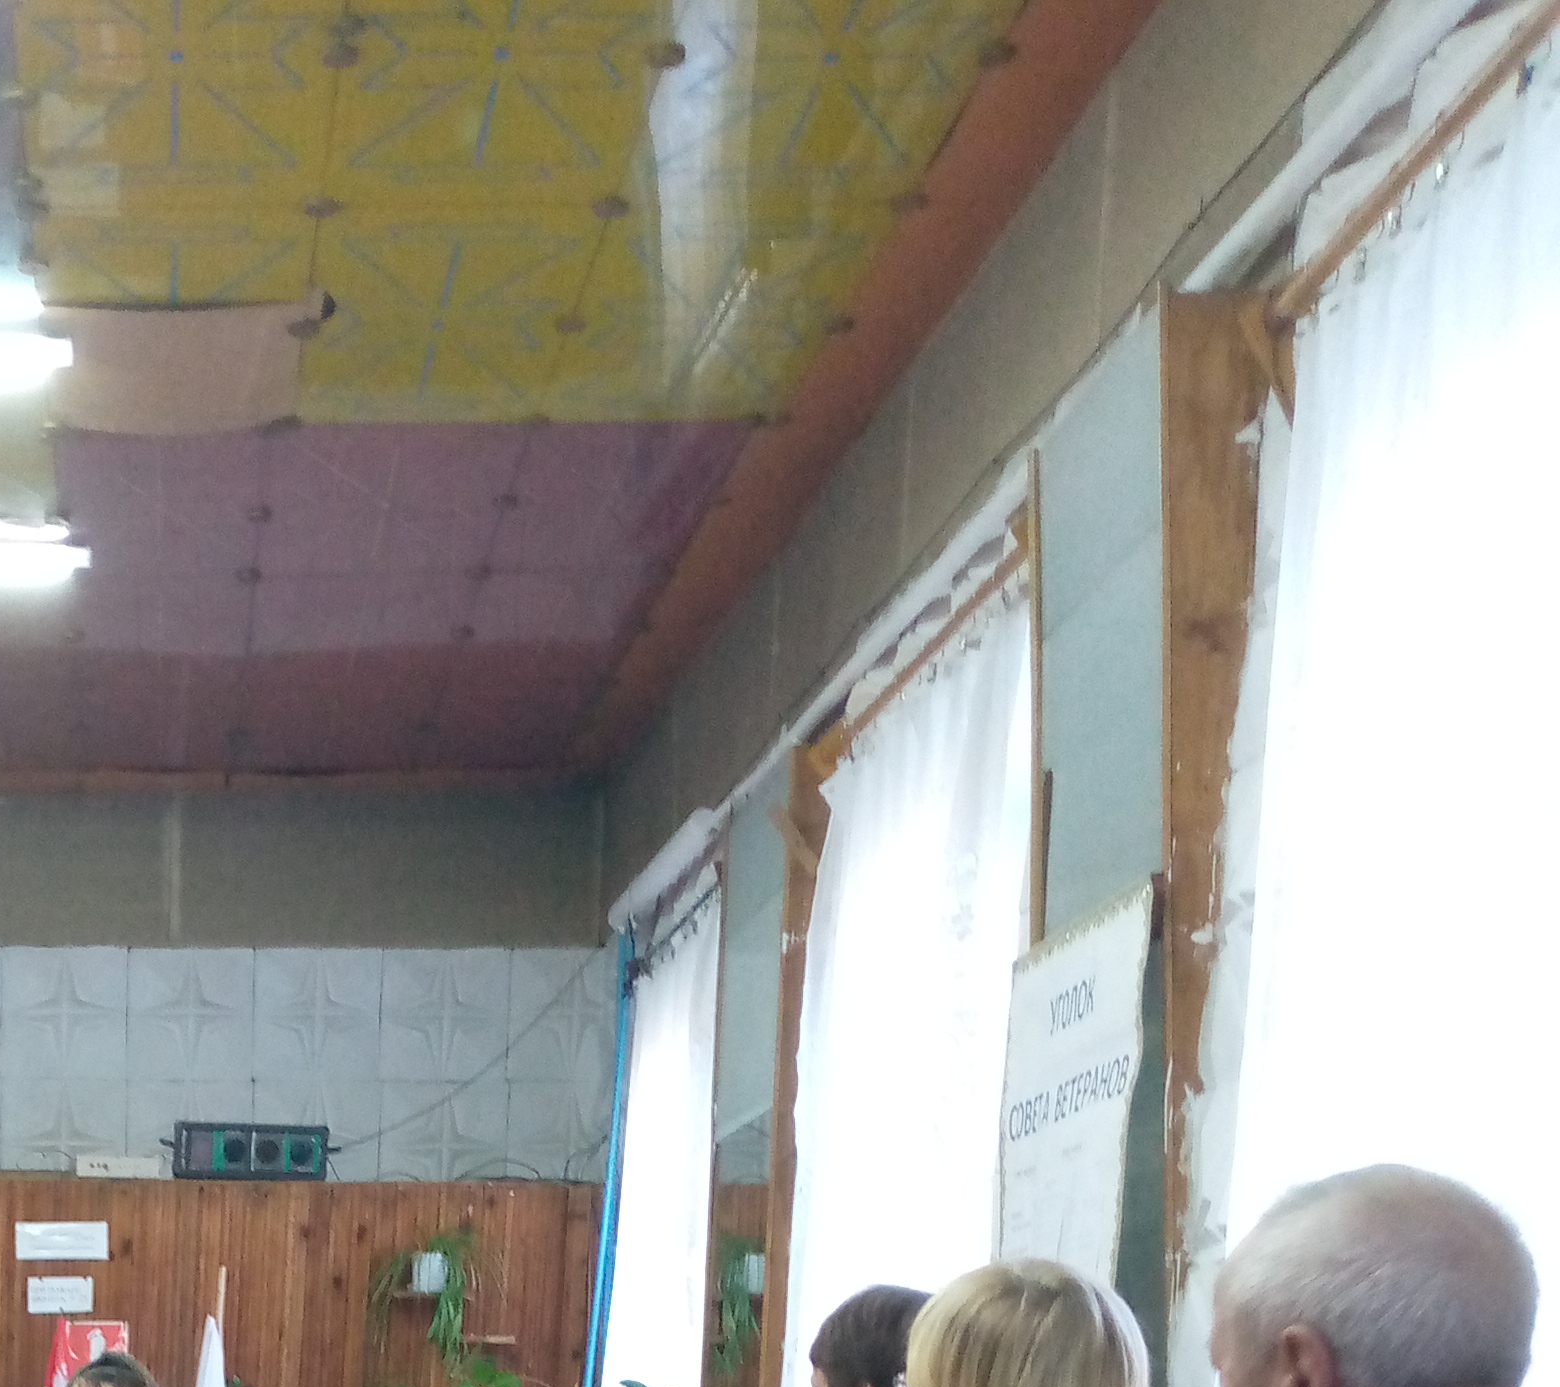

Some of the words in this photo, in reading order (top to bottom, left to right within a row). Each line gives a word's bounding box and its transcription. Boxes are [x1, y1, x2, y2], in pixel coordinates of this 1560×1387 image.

[1050, 974, 1095, 1036] УГОЛОК
[1009, 1090, 1050, 1142] СОВЕТА
[1054, 1054, 1130, 1123] ВЕТЕРАНОВ
